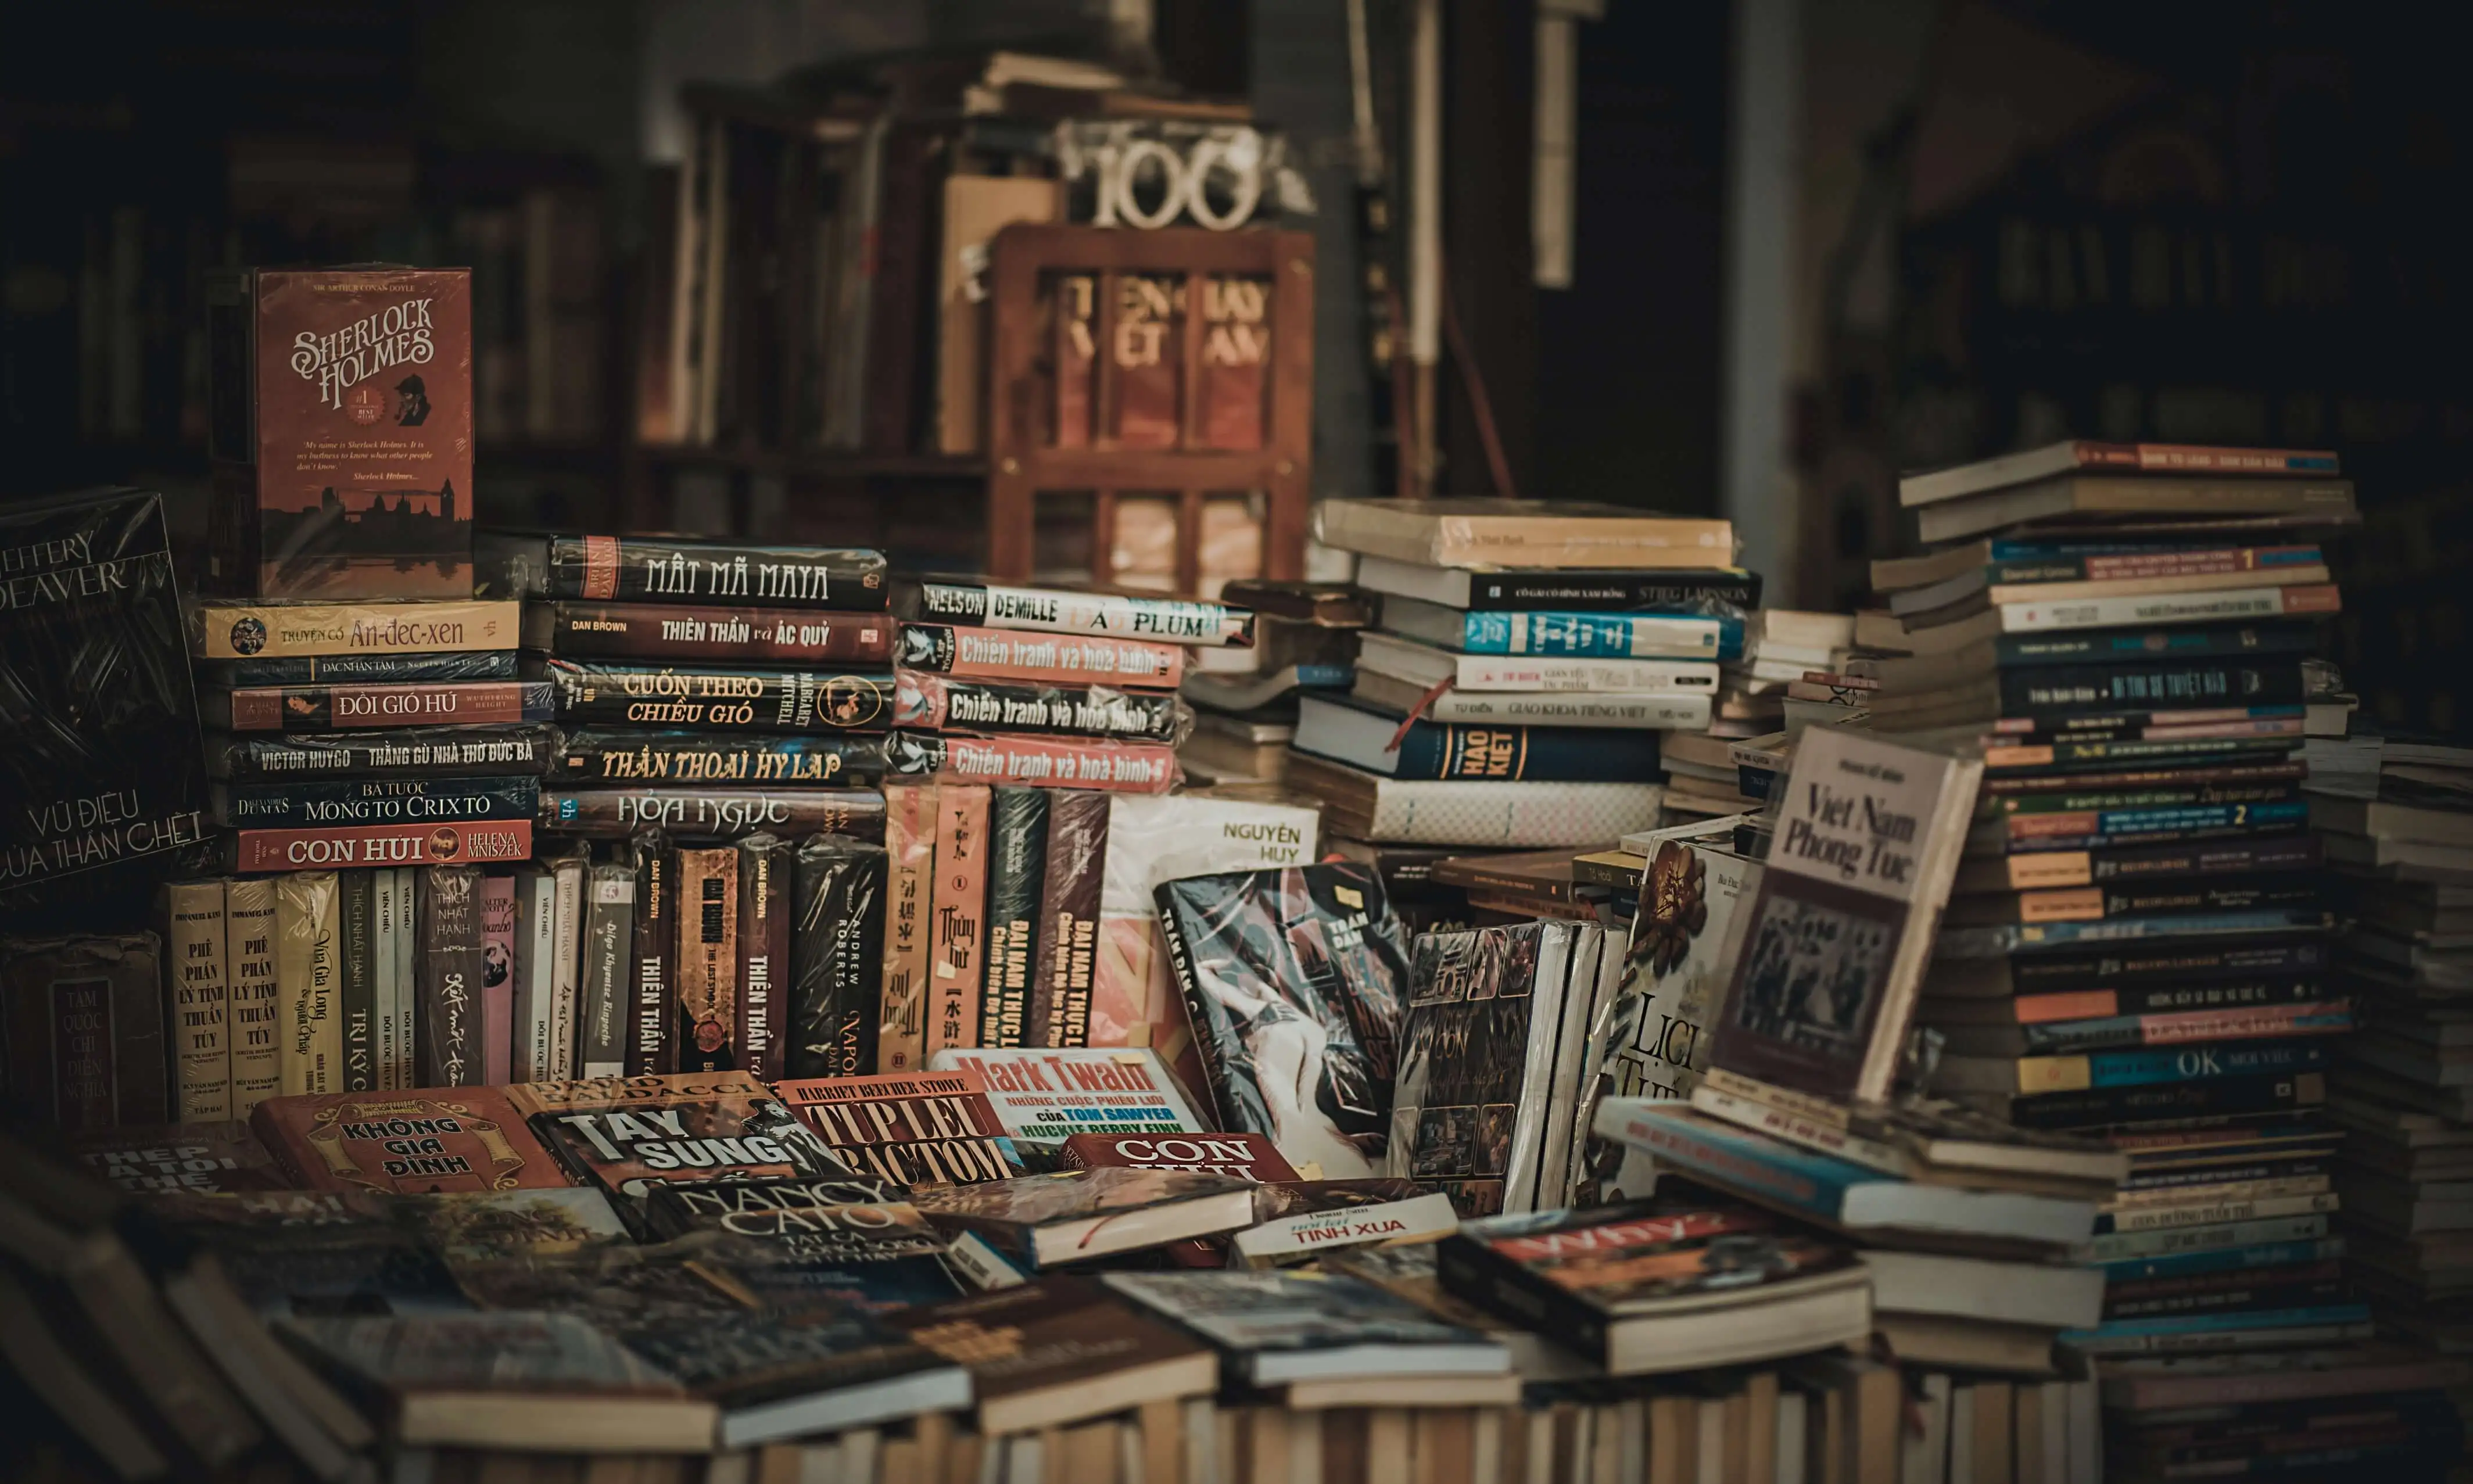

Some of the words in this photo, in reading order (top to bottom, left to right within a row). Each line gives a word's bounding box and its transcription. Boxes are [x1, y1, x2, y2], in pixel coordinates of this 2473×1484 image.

[291, 298, 434, 379] SHERLOCK
[319, 329, 434, 410] HOLMES
[409, 451, 433, 461] people
[1, 530, 94, 573] EFFERY
[645, 552, 700, 596] MẬT
[708, 556, 748, 596] MÃ
[757, 563, 830, 601] MAYA
[571, 620, 592, 632] DAN
[592, 621, 627, 633] BROWN
[662, 616, 706, 643] THIÊN
[709, 615, 750, 644] THẦN
[753, 626, 772, 642] và
[774, 620, 797, 646] ÁC
[960, 632, 1009, 665] Chiến
[1013, 640, 1056, 667] tranh
[1060, 643, 1080, 670] và
[623, 668, 693, 698] CUỐN
[698, 676, 764, 698] THEO
[339, 690, 378, 716] ĐỒI
[382, 691, 421, 714] GIÓ
[424, 690, 457, 713] HÚ
[465, 693, 517, 703] WUTHERING
[474, 700, 508, 709] HEIGHT
[776, 674, 795, 726] MITCHELL
[794, 672, 813, 729] MARGARET
[951, 691, 1003, 722] Chiến
[1003, 702, 1048, 726] tranh
[1052, 701, 1070, 727] và
[627, 697, 705, 722] CHIỀU
[709, 701, 754, 723] GIÓ
[261, 751, 306, 772] VICTOR
[309, 749, 351, 769] HUYGO
[368, 741, 409, 767] THẰNG
[413, 746, 430, 765] GÙ
[433, 741, 460, 765] NHÀ
[488, 739, 514, 762] ĐỨC
[515, 737, 535, 761] BÀ
[956, 746, 1005, 775] Chiến
[1008, 752, 1051, 778] tranh
[1055, 754, 1076, 780] và
[238, 797, 289, 815] DUMAS
[562, 800, 576, 819] vh
[287, 838, 356, 863] CON
[363, 833, 424, 861] HỦI
[468, 831, 517, 847] HELENA
[468, 843, 523, 859] MNISZEK
[650, 860, 661, 880] DAN
[757, 860, 767, 880] DAN
[436, 891, 469, 905] THÍCH
[650, 881, 661, 919] BROWN
[757, 881, 767, 919] BROWN
[438, 906, 469, 920] NHẤT
[436, 924, 471, 938] HẠNH
[188, 938, 213, 958] PHÊ
[245, 935, 268, 955] PHÊ
[708, 948, 716, 962] THE
[835, 919, 848, 988] ROBERTS
[849, 918, 861, 985] ANDREW
[185, 961, 217, 981] PHÁN
[241, 958, 272, 978] PHÁN
[1005, 950, 1027, 988] NAM
[1070, 950, 1091, 988] NAM
[179, 985, 194, 1005] LÝ
[199, 984, 224, 1003] TÍNH
[234, 981, 250, 1001] LÝ
[253, 982, 277, 999] TÍNH
[192, 1031, 217, 1049] TÚY
[247, 1027, 270, 1046] TÚY
[957, 1056, 1055, 1094] Mark
[1043, 1056, 1160, 1093] Twain
[545, 1084, 757, 1103] BALDACCI
[796, 1085, 859, 1102] HARRIET
[862, 1080, 918, 1098] BEECHER
[920, 1078, 969, 1095] STOWE
[1037, 1108, 1066, 1123] CỦA
[1066, 1107, 1104, 1122] TOM
[1104, 1107, 1177, 1121] SAWYER
[340, 1117, 463, 1140] KHÔNG
[559, 1109, 689, 1161] TAY
[383, 1138, 446, 1156] GIA
[1114, 1139, 1257, 1163] CON
[382, 1155, 473, 1177] ĐÌNH
[680, 1178, 891, 1214] NANCY
[721, 1205, 895, 1236] CATO
